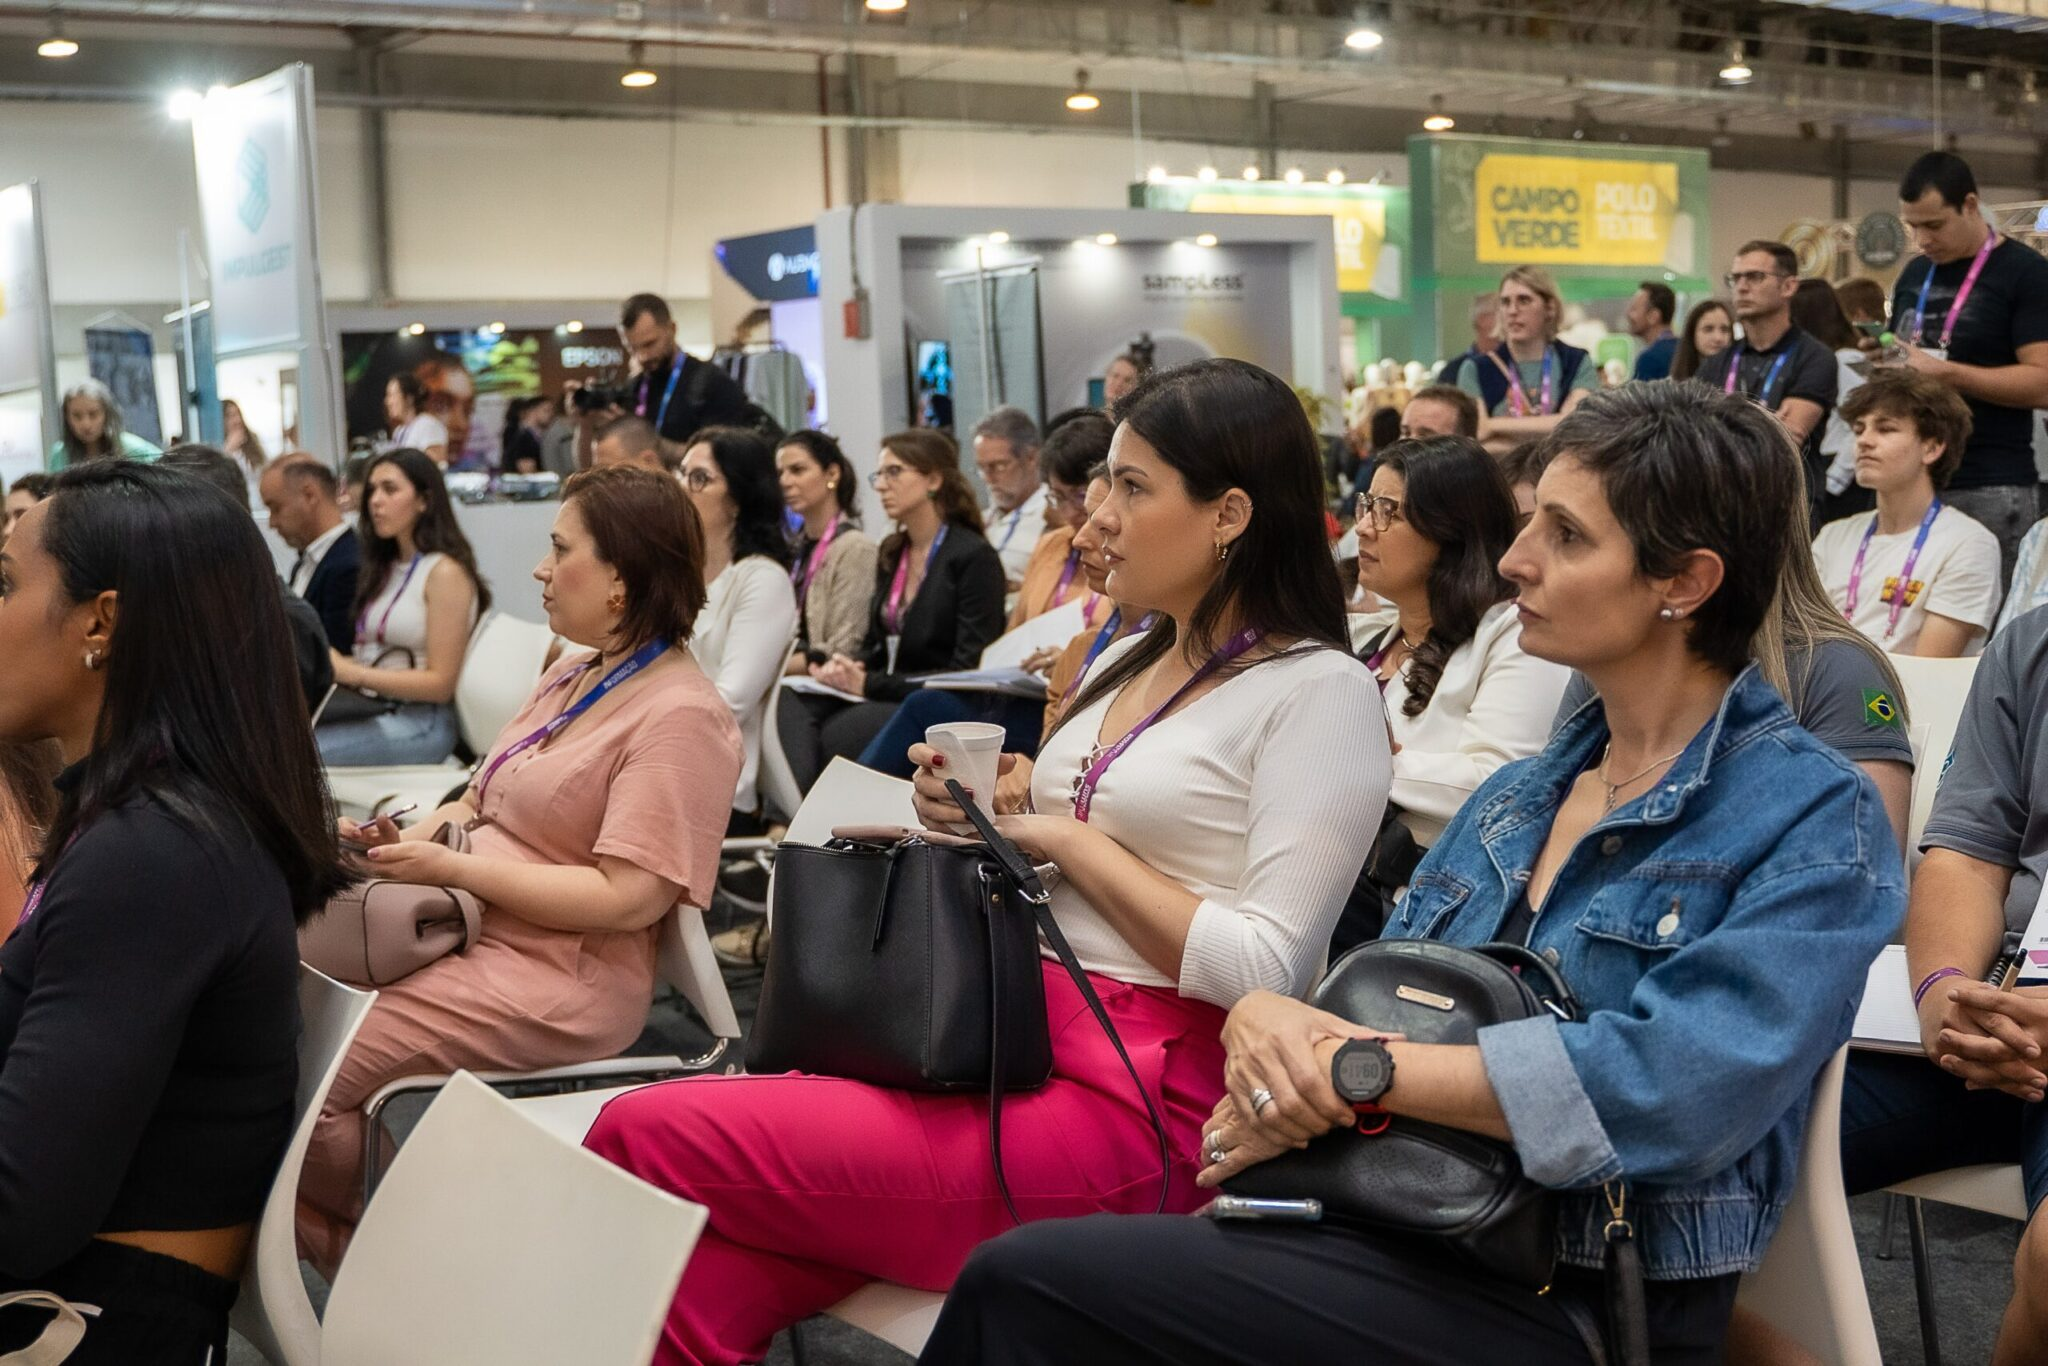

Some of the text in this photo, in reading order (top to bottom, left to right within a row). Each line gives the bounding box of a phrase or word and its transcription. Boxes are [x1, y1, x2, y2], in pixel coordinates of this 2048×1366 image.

[1490, 184, 1580, 214] CAMPO
[1595, 181, 1657, 212] POLO
[1492, 218, 1580, 248] VERDE
[561, 346, 624, 368] EPSON
